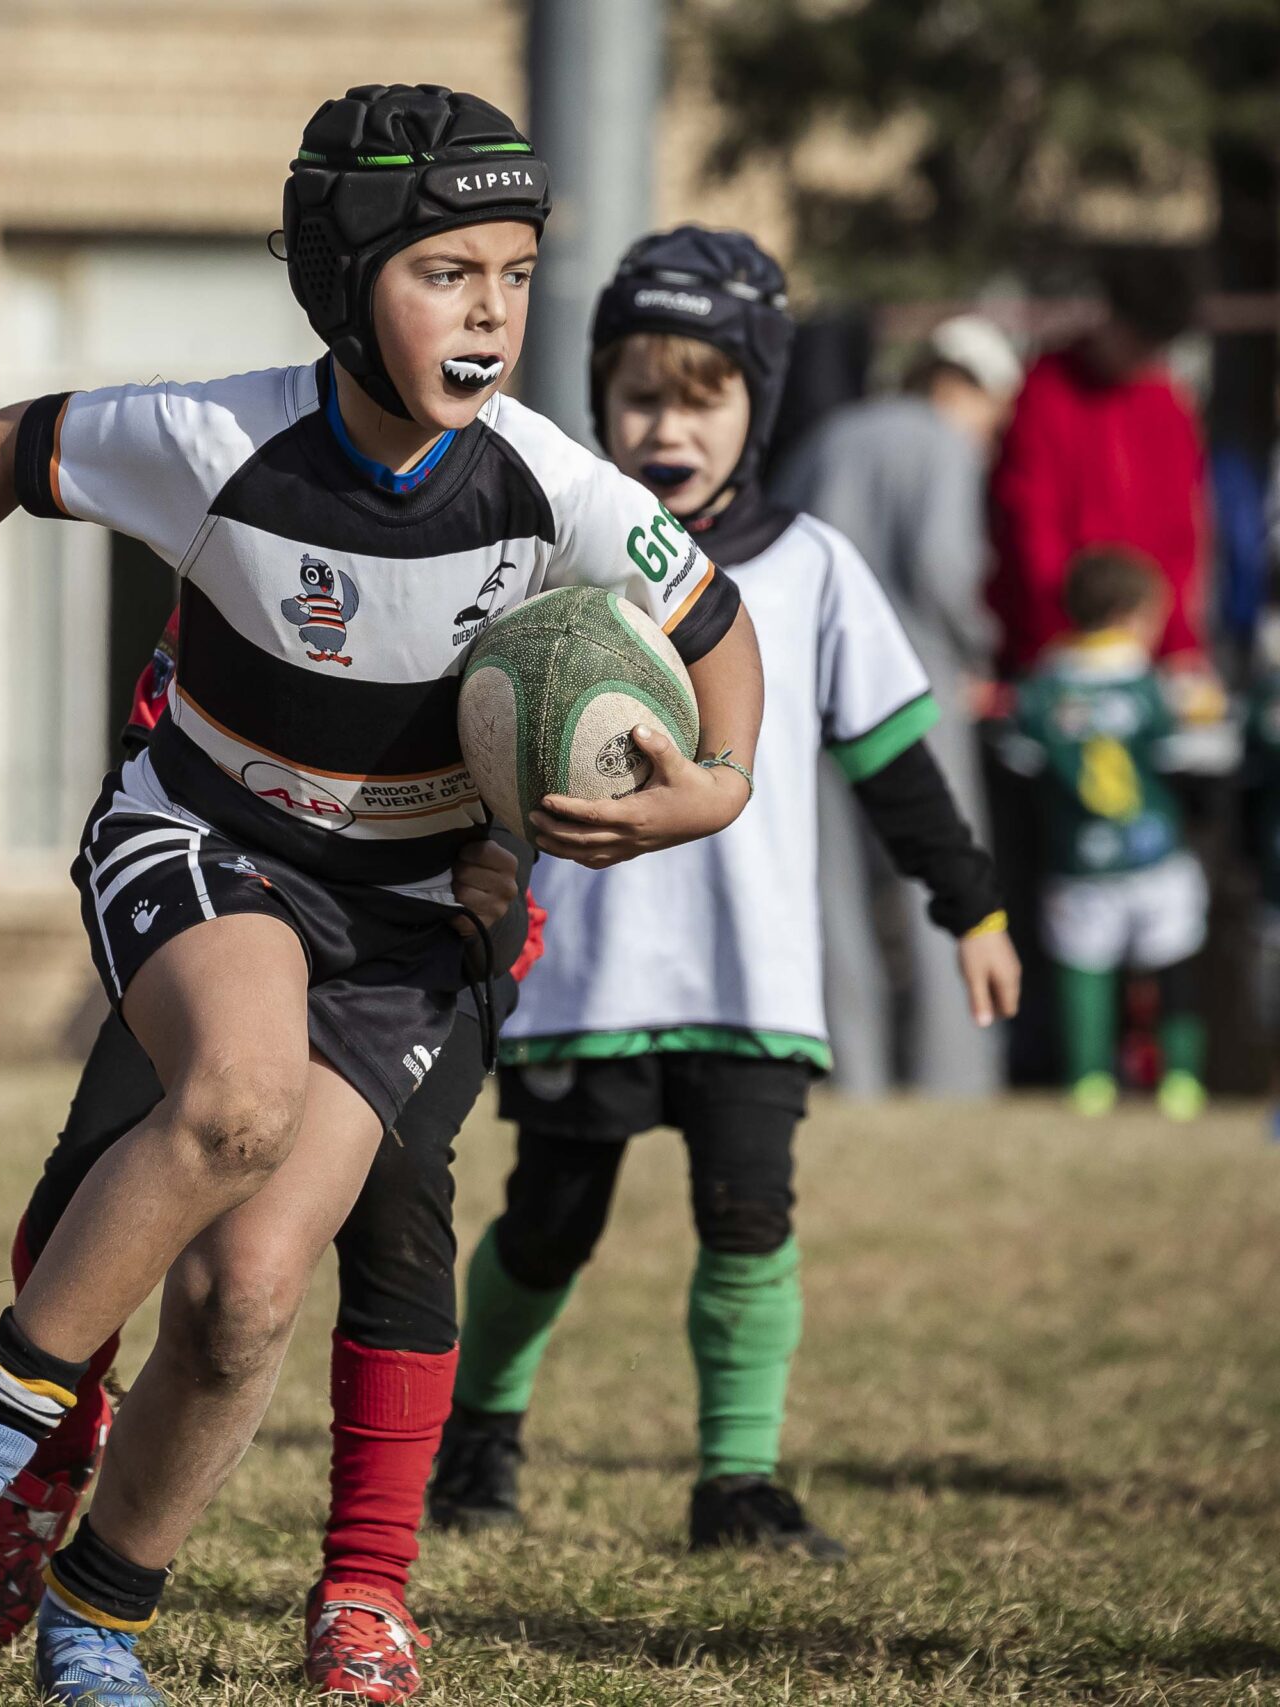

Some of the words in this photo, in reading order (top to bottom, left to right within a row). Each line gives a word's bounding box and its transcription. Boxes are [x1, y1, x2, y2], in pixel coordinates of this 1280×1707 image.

[456, 170, 534, 192] KIPSTA
[360, 784, 421, 796] ARIDOS
[425, 781, 435, 790] Y
[441, 770, 471, 787] HOR
[363, 791, 437, 807] PUENTE
[440, 783, 461, 798] DE
[463, 780, 477, 791] L
